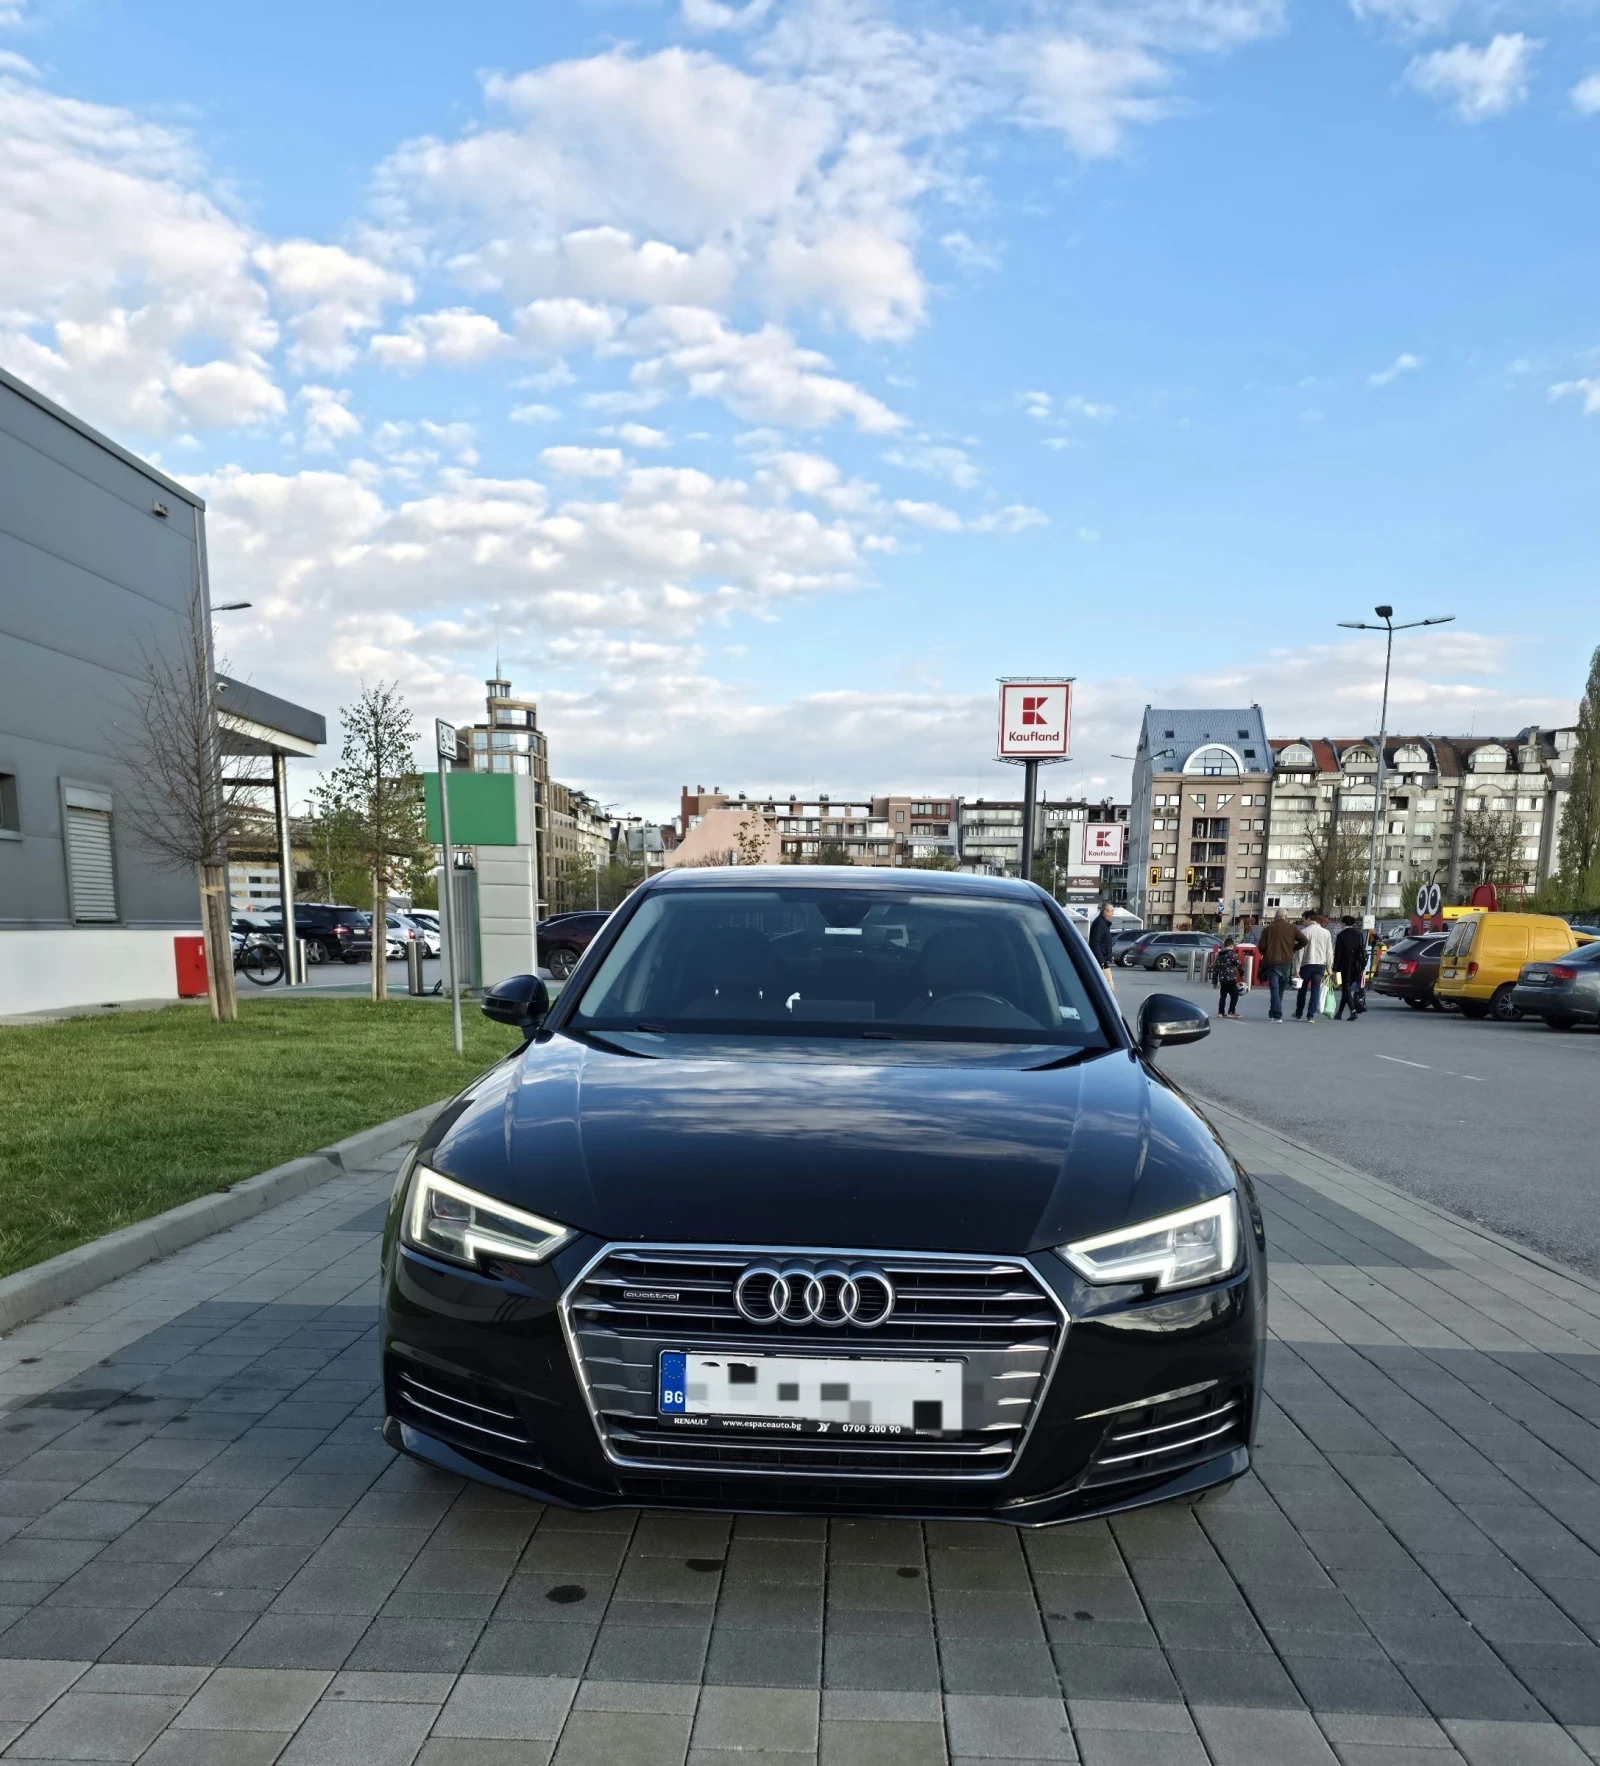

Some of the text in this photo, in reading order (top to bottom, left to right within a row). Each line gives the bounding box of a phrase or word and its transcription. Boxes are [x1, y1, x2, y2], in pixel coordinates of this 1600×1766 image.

[1022, 697, 1048, 724] K
[1009, 731, 1059, 741] Kaufland
[1096, 831, 1111, 846] K
[664, 1390, 684, 1404] BG
[674, 1418, 901, 1434] RENAULT www.espaceauto.bg 0700 200 90
